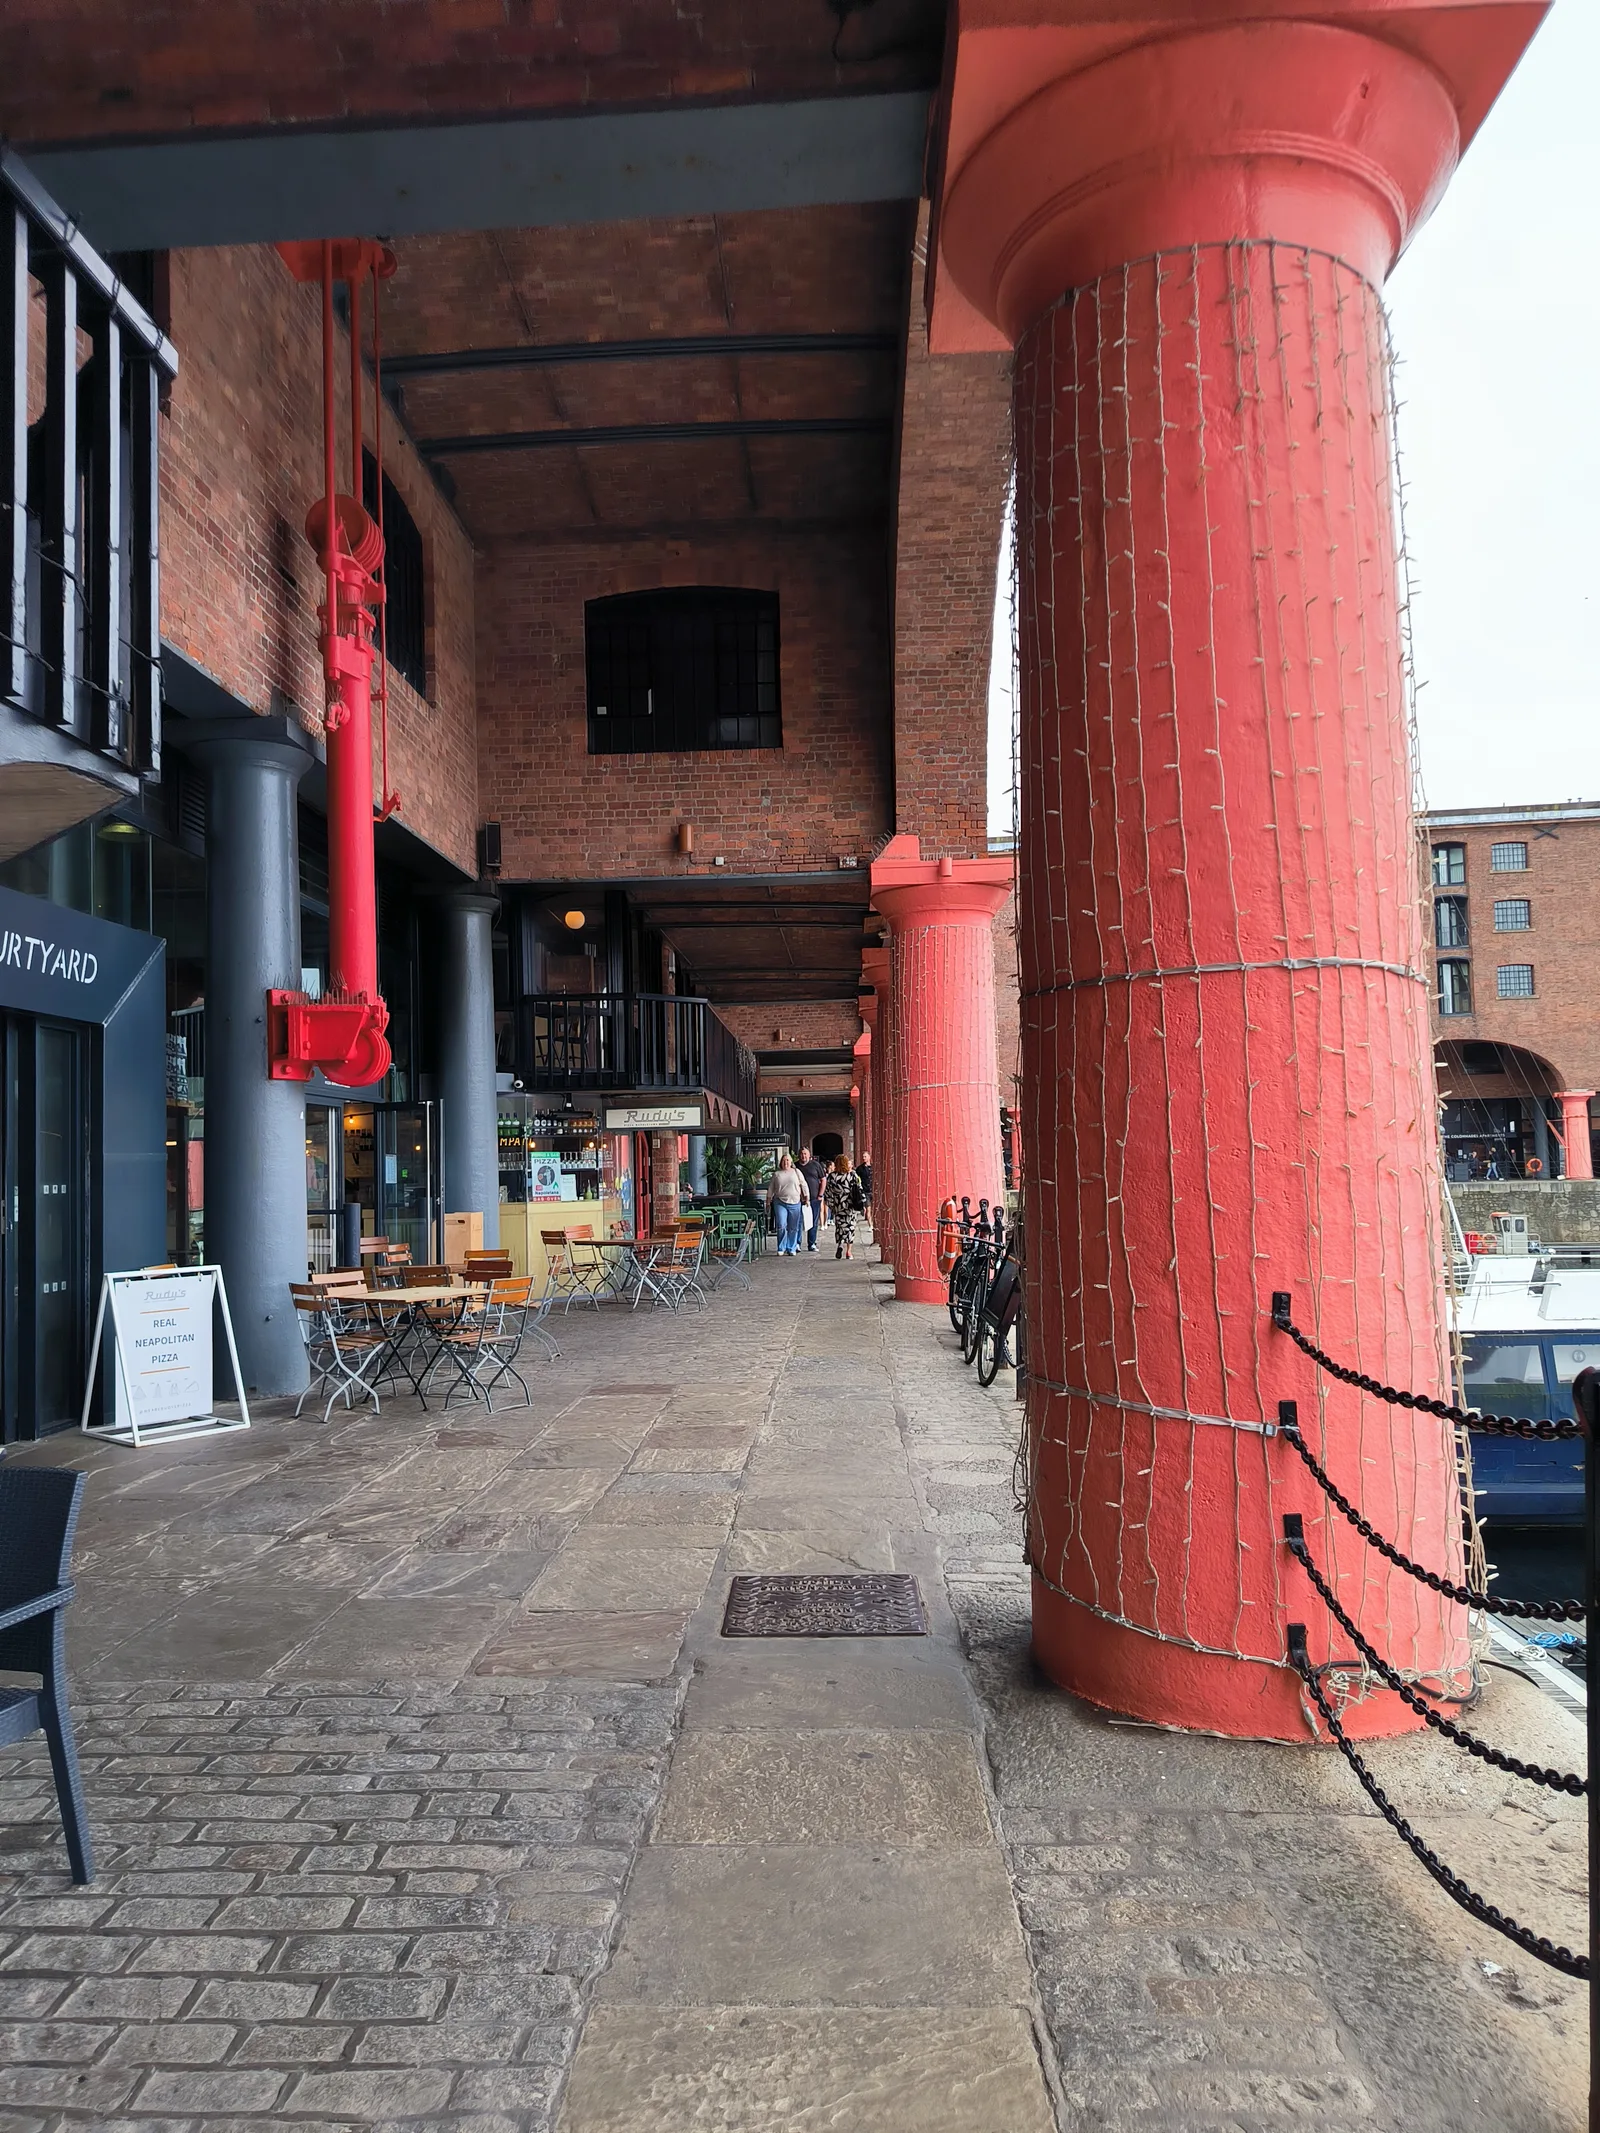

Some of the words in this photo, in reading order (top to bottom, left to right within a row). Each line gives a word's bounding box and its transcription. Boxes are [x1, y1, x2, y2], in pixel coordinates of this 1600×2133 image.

[623, 1109, 685, 1125] Rudy's
[143, 1289, 187, 1302] Rudy's
[153, 1318, 177, 1328] REAL
[135, 1333, 195, 1348] NEAPOLITAN
[151, 1353, 179, 1364] PIZZA
